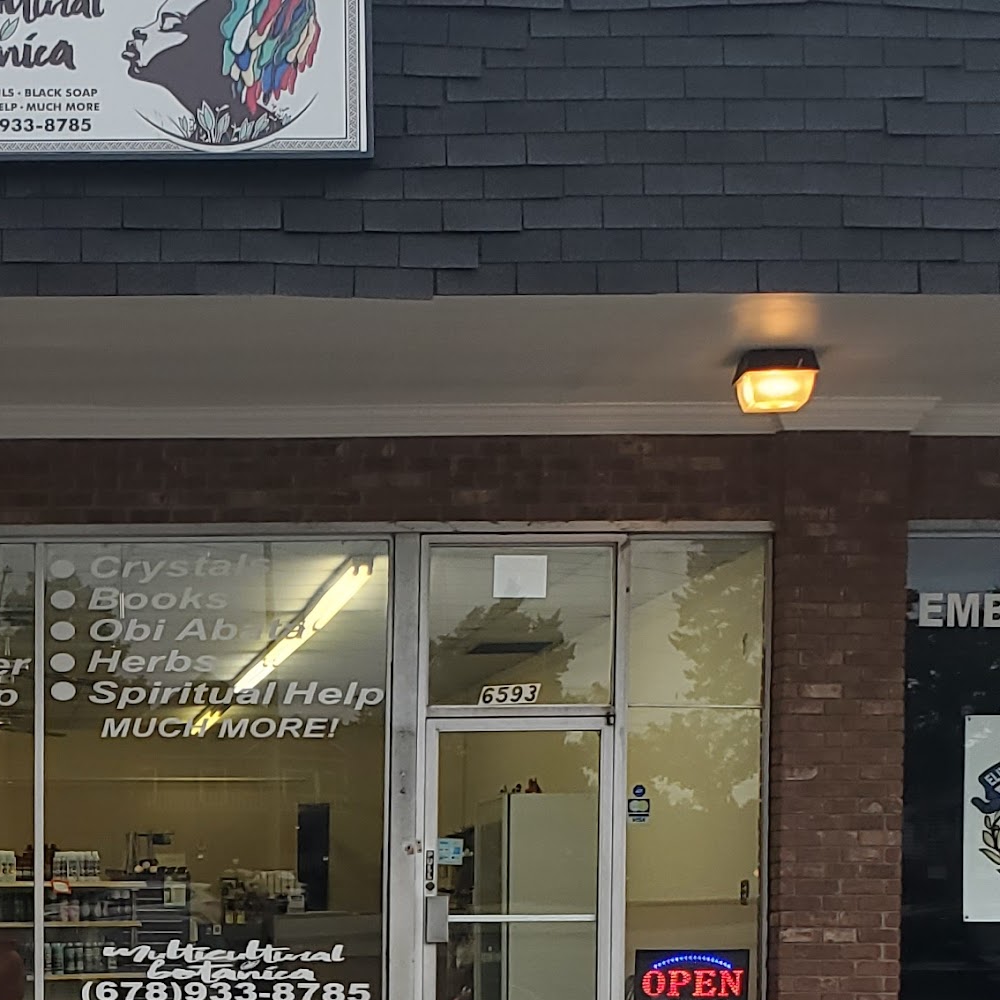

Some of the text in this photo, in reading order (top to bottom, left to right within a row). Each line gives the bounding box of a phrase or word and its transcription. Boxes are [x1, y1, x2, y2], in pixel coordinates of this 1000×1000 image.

[24, 88, 62, 98] BLACK
[65, 88, 98, 98] SOAP
[26, 102, 62, 112] MUCH
[65, 102, 100, 112] MORE
[87, 587, 229, 611] Books
[89, 617, 168, 642] Obi
[87, 649, 218, 674] Herbs
[87, 680, 385, 712] Spiritual Help
[482, 685, 537, 704] 6593
[100, 717, 341, 739] MUCH MORE!
[641, 969, 744, 998] OPEN
